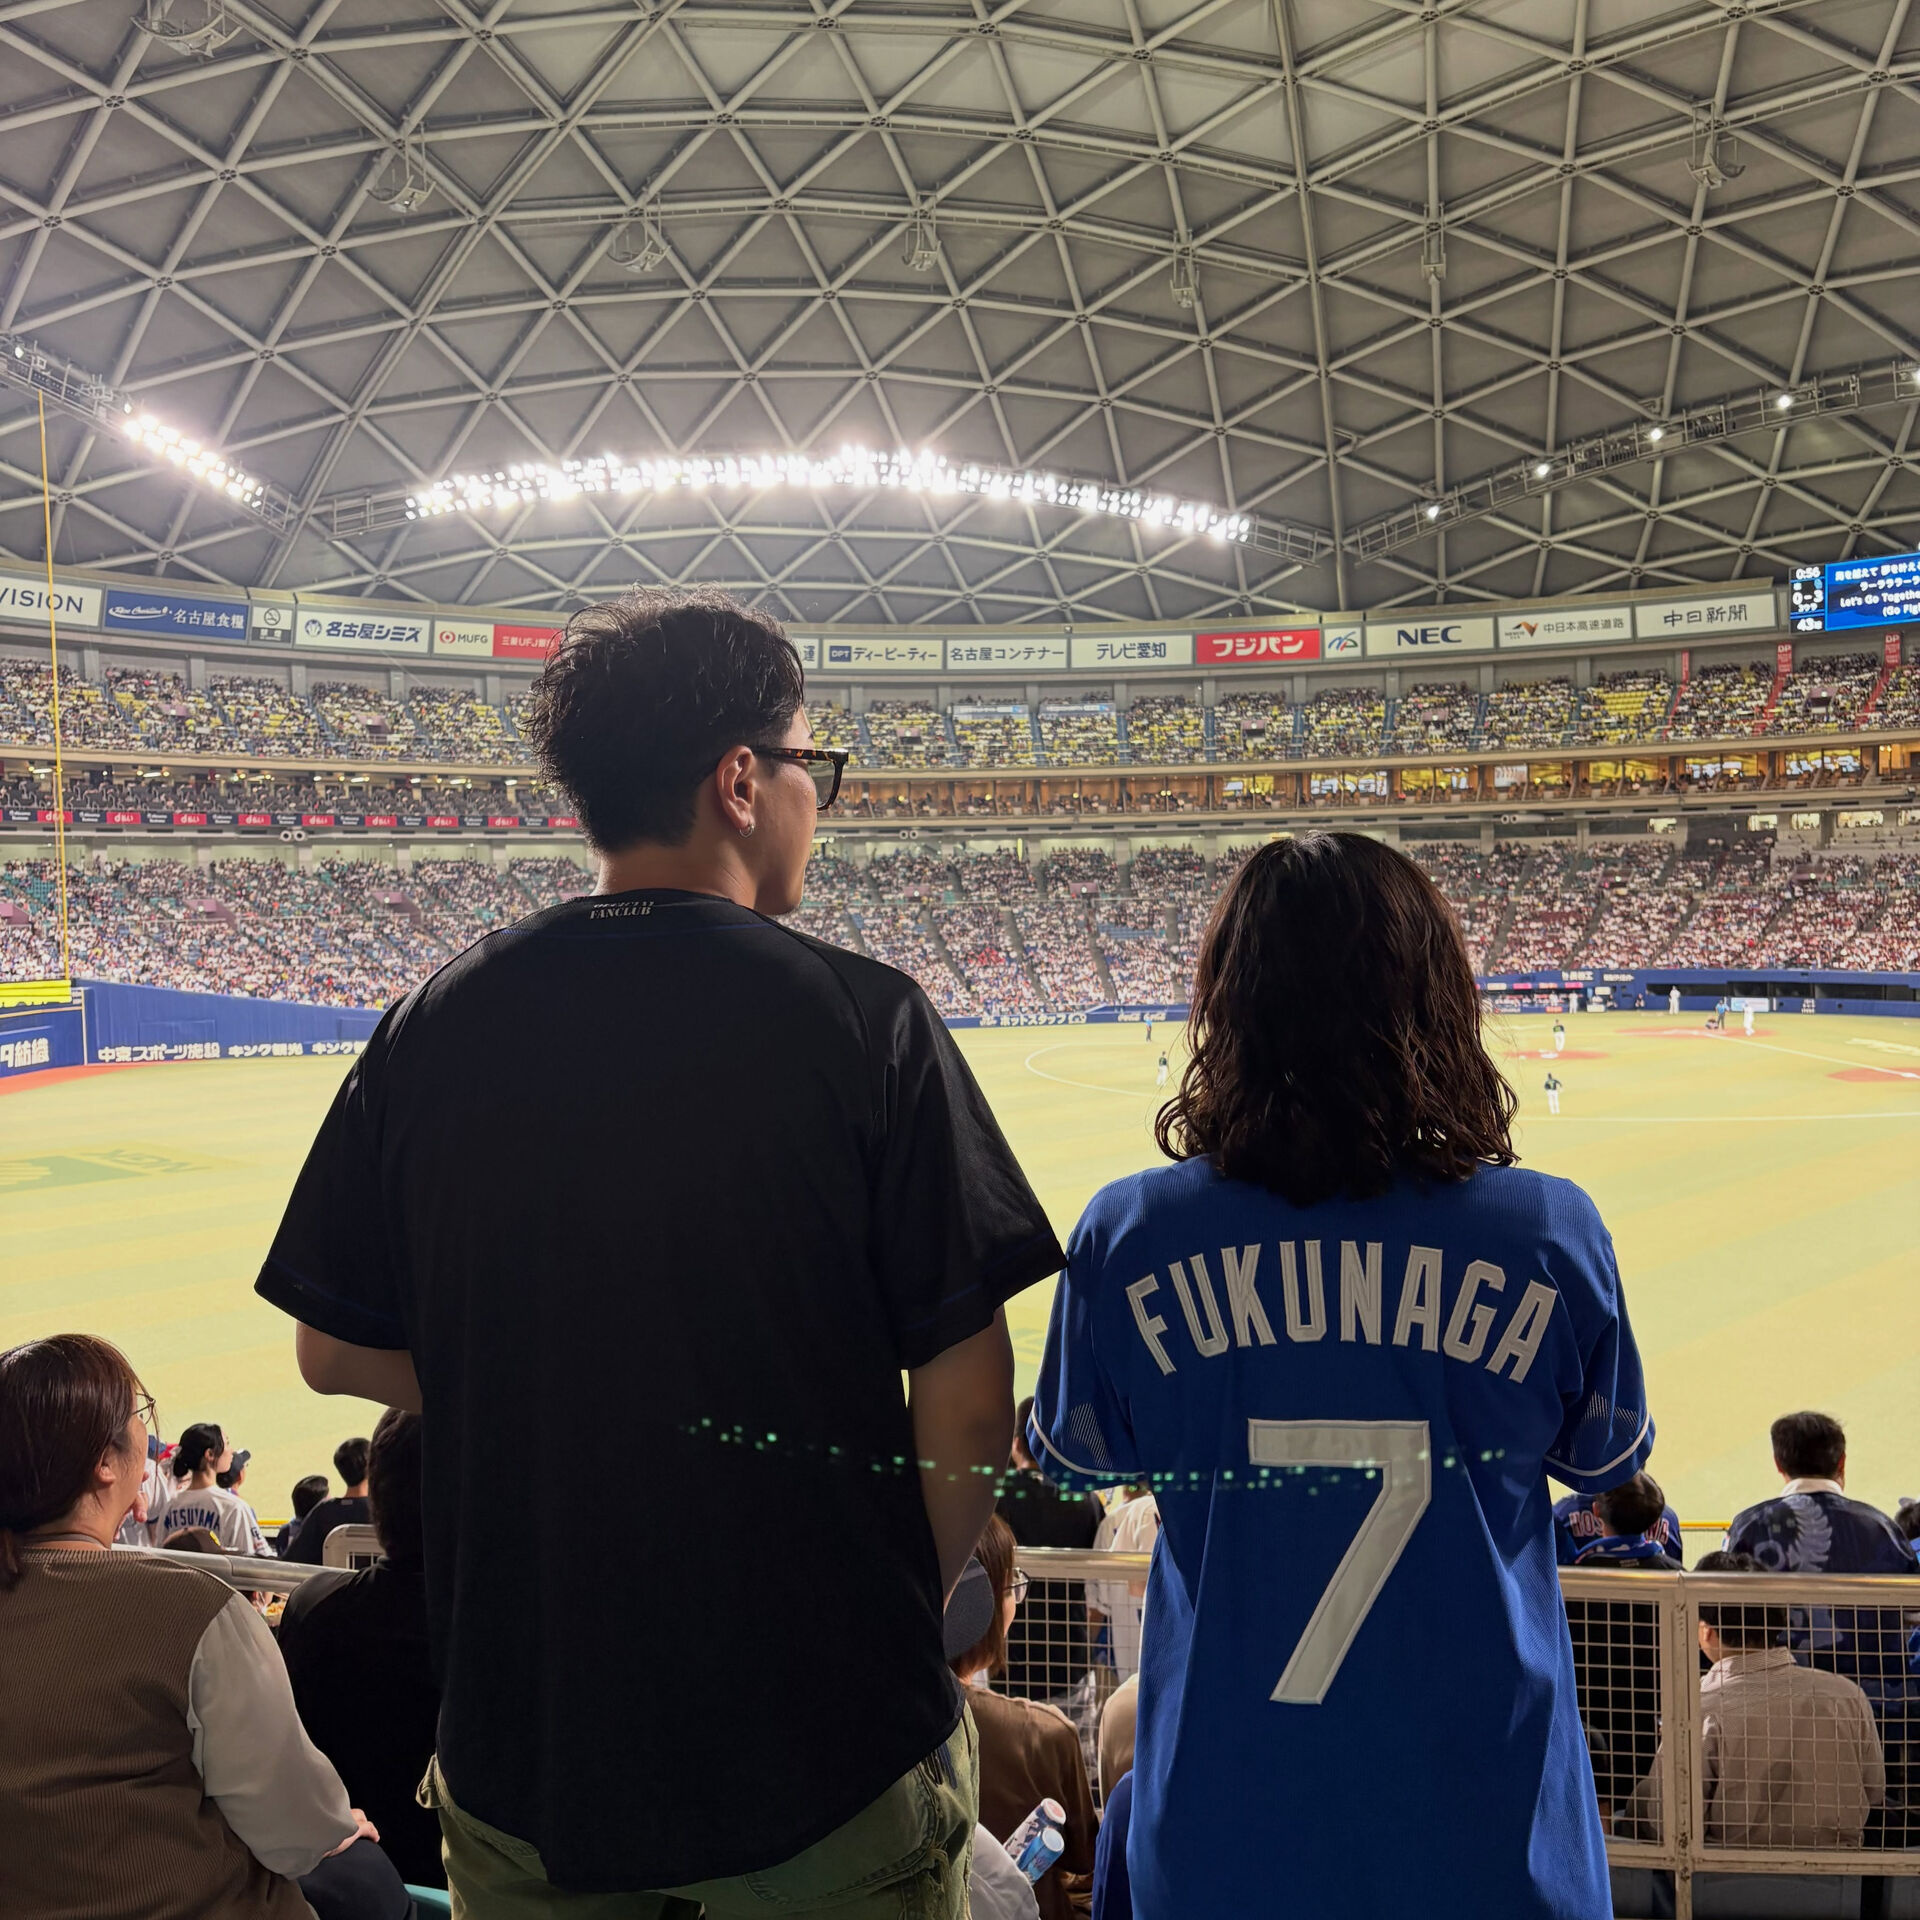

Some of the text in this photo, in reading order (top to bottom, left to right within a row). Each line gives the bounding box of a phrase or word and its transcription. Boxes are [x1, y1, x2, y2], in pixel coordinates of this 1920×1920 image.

[1865, 595, 1879, 604] Go
[1663, 603, 1748, 628] 中日新聞
[325, 621, 422, 643] 名古屋シミズ
[1543, 618, 1624, 634] 中日本高速道路
[457, 633, 488, 645] MUFG
[1397, 626, 1461, 646] NEC
[853, 647, 937, 662] ディービーティー
[950, 646, 1065, 662] 名古屋コンテナー
[1097, 642, 1167, 660] テレビ愛知
[1213, 636, 1304, 657] フジパン
[590, 907, 651, 919] FANCLUB
[1125, 1240, 1558, 1384] FUKUNAGA
[1248, 1418, 1432, 1705] 7
